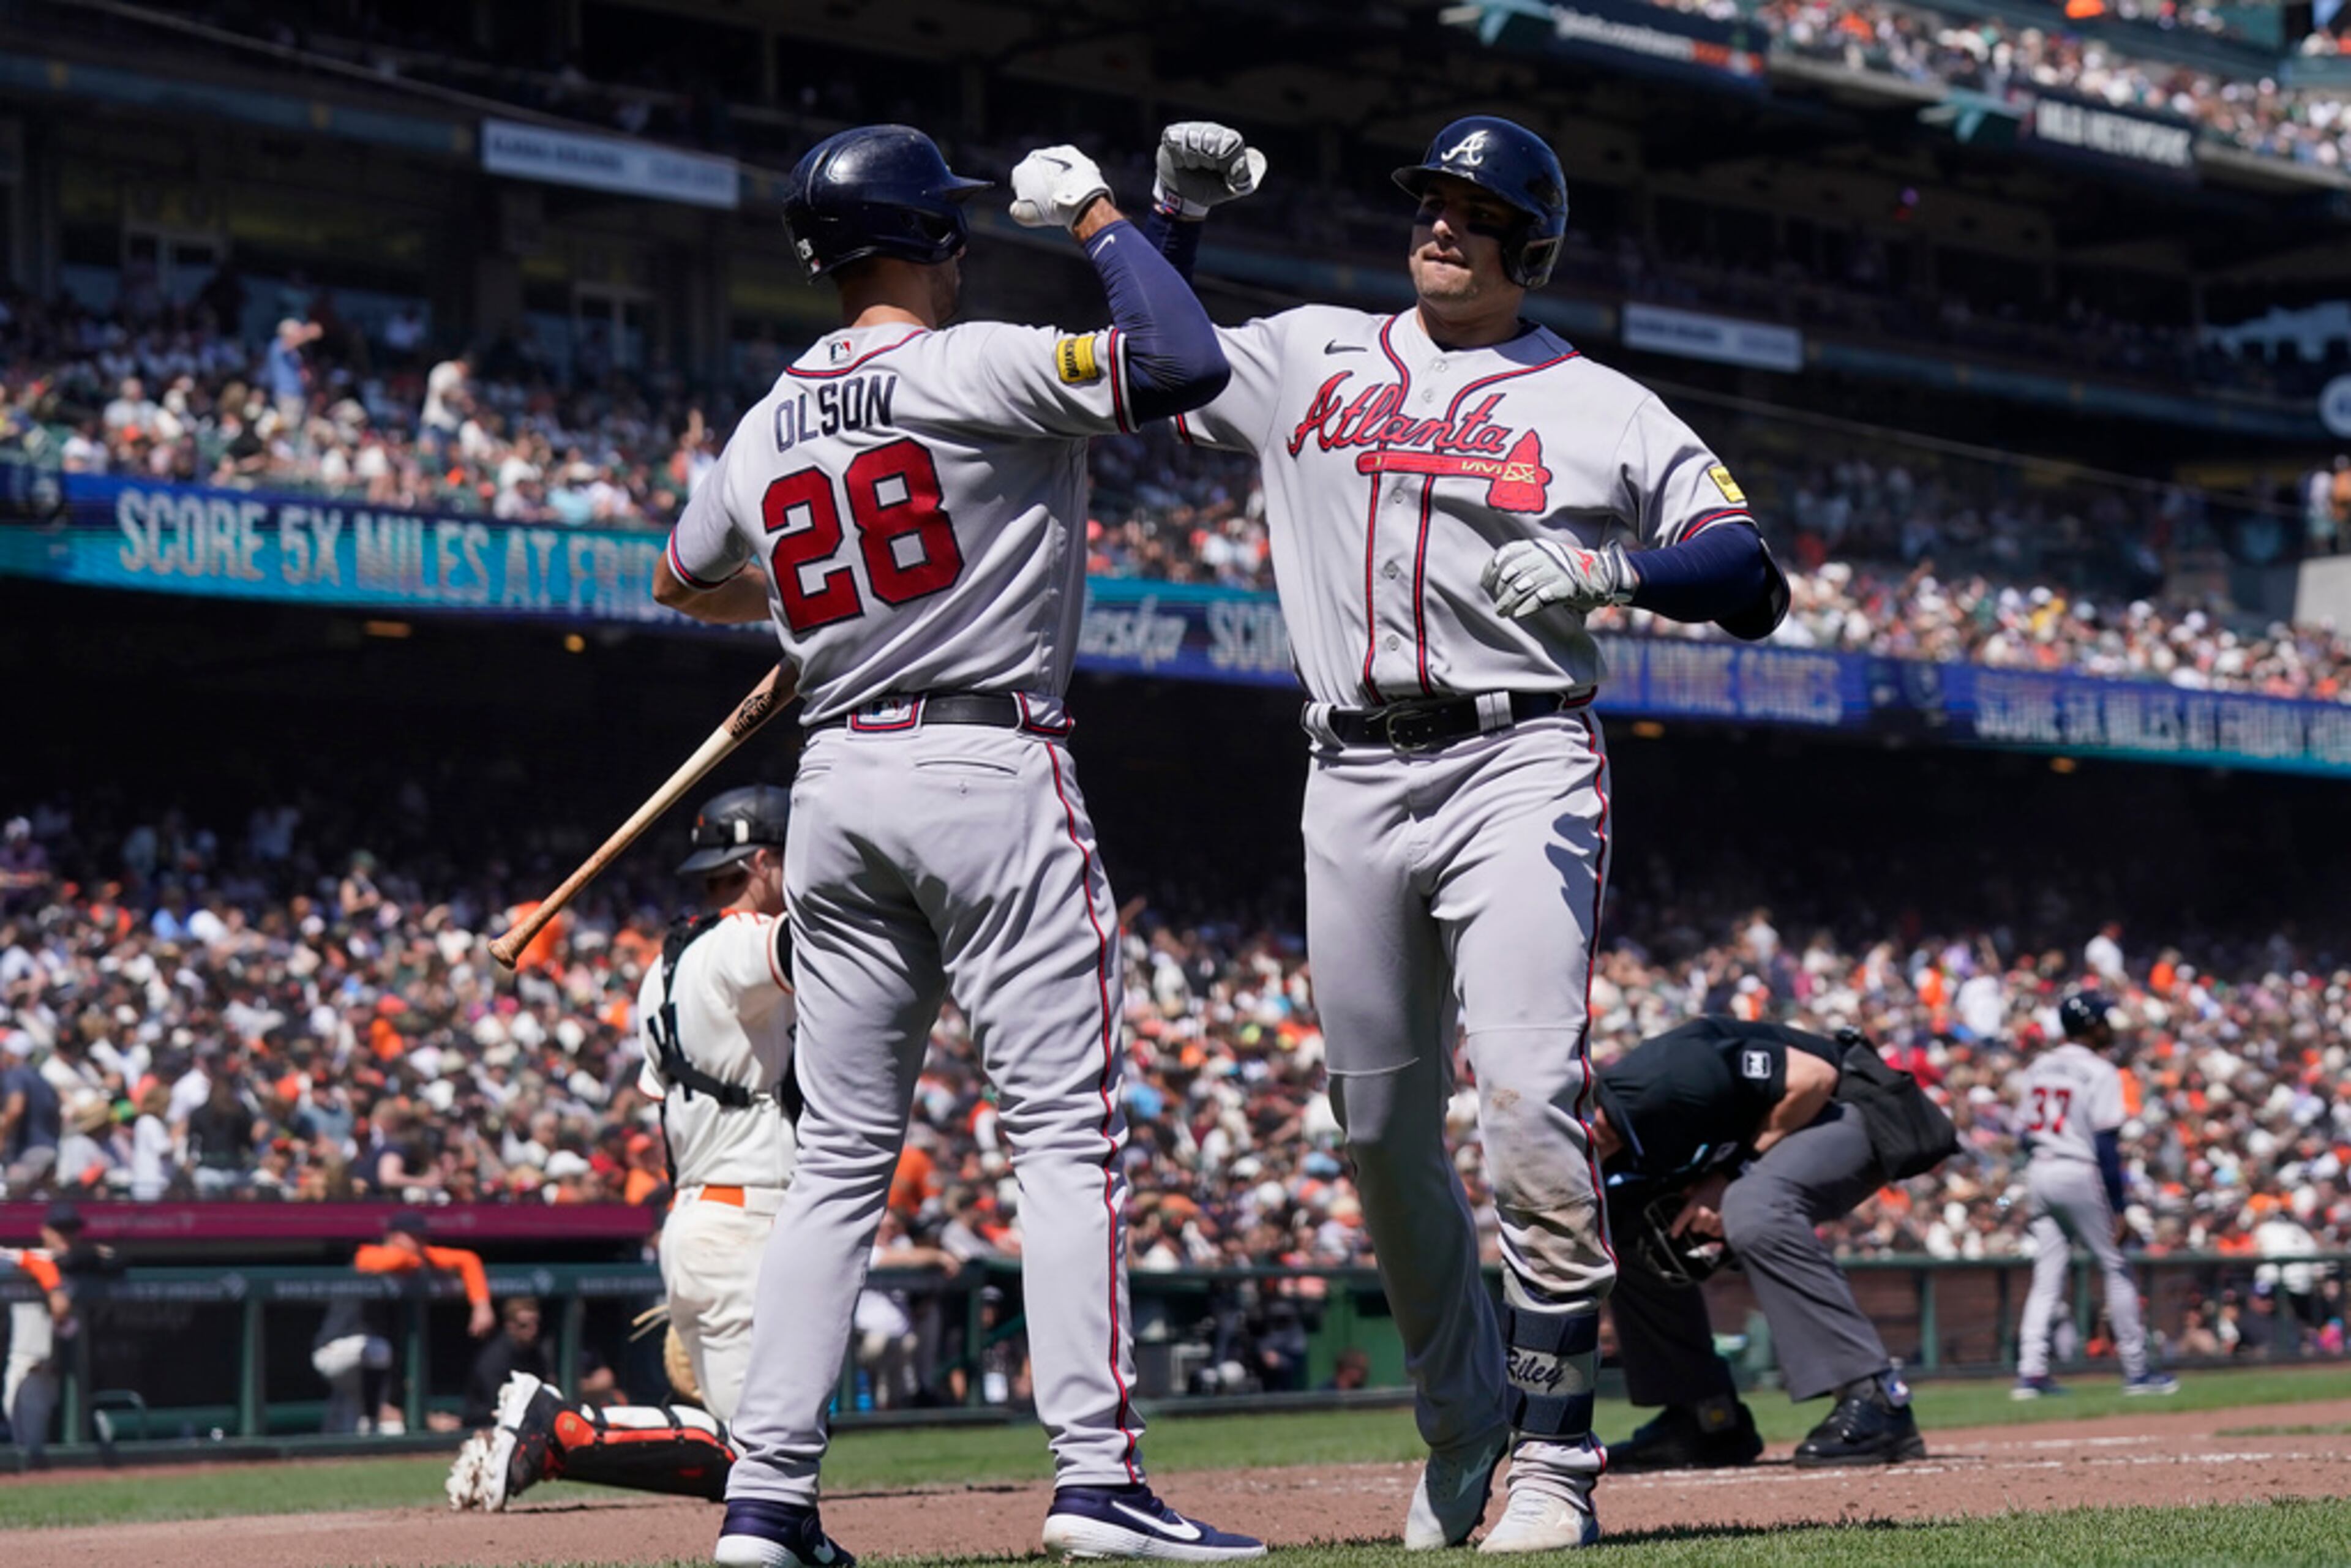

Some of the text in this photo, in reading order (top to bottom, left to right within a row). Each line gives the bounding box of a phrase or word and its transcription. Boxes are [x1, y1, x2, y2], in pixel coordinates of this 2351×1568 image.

[1440, 129, 1490, 167] A
[774, 374, 897, 454] OLSON
[1286, 370, 1513, 460] Atlanta
[116, 488, 667, 623] SCORE 5X MILES AT FRID
[761, 436, 966, 635] 28
[1206, 598, 1289, 675] SCO
[2027, 1086, 2072, 1135] 37
[1505, 1348, 1564, 1394] Riley
